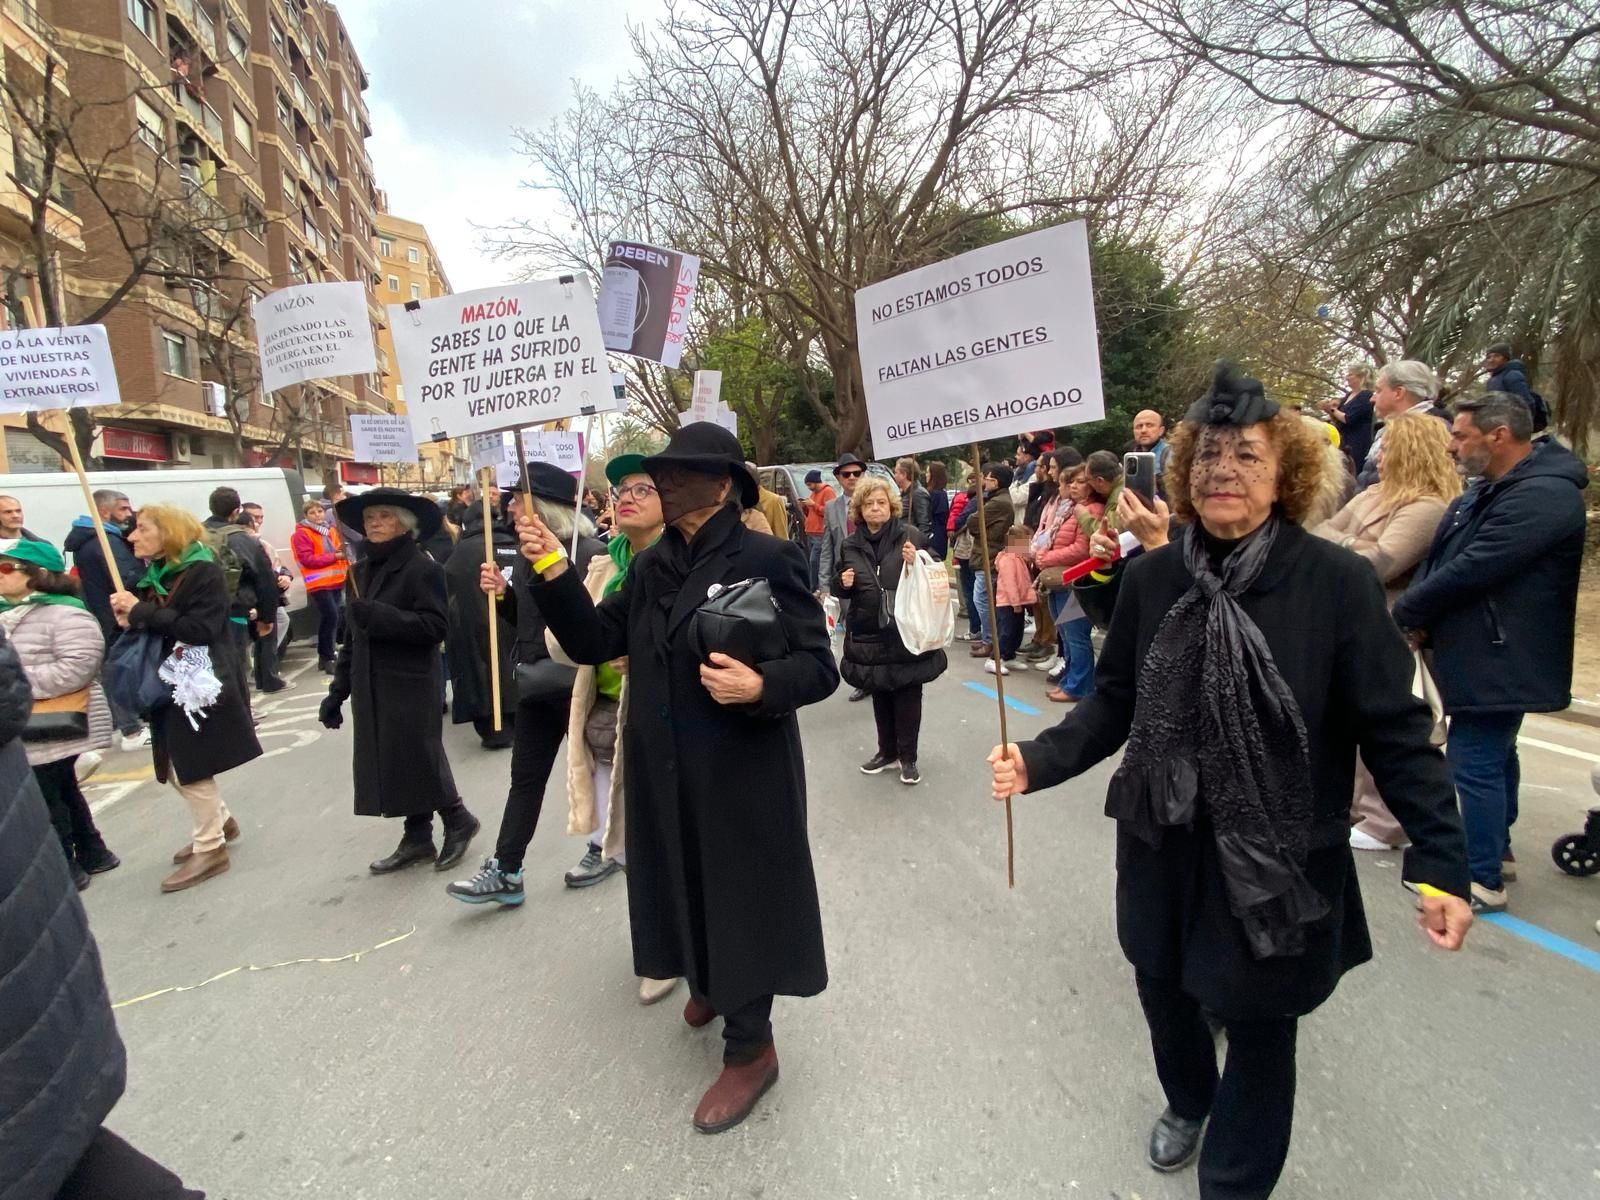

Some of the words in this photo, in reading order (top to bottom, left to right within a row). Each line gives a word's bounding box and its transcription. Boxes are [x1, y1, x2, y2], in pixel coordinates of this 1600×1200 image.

[615, 245, 668, 268] DEBEN
[872, 304, 892, 322] NO
[896, 277, 972, 314] ESTAMOS
[975, 256, 1044, 288] TODOS
[274, 294, 315, 314] MAZÓN
[461, 296, 522, 324] MAZÓN,
[278, 321, 322, 338] PENSADO
[325, 319, 346, 328] LAS
[431, 328, 480, 354] SABES
[488, 324, 506, 342] LO
[514, 318, 544, 338] QUE
[552, 314, 570, 332] LA
[0, 340, 12, 350] O
[16, 338, 25, 348] A
[28, 338, 44, 348] LA
[47, 335, 92, 346] VENTA
[264, 331, 336, 356] CONSECUENCIAS
[339, 330, 354, 338] DE
[274, 348, 307, 364] JUERGA
[310, 344, 323, 354] EN
[326, 343, 342, 352] EL
[878, 355, 931, 382] FALTAN
[935, 346, 966, 366] LAS
[971, 326, 1048, 357] GENTES
[1, 356, 17, 366] DE
[21, 350, 90, 364] NUESTRAS
[279, 355, 335, 374] VENTORRO?
[428, 352, 476, 378] GENTE
[483, 348, 503, 366] HA
[510, 336, 580, 362] SUFRIDO
[6, 368, 77, 382] VIVIENDAS
[82, 367, 90, 376] A
[421, 382, 454, 402] POR
[463, 376, 480, 394] TU
[486, 364, 546, 390] JUERGA
[554, 360, 574, 378] EN
[582, 357, 598, 374] EL
[4, 382, 100, 398] EXTRANJEROS!
[468, 386, 562, 417] VENTORRO?
[886, 421, 917, 440] QUE
[921, 408, 980, 432] HABEIS
[984, 388, 1082, 420] AHOGADO
